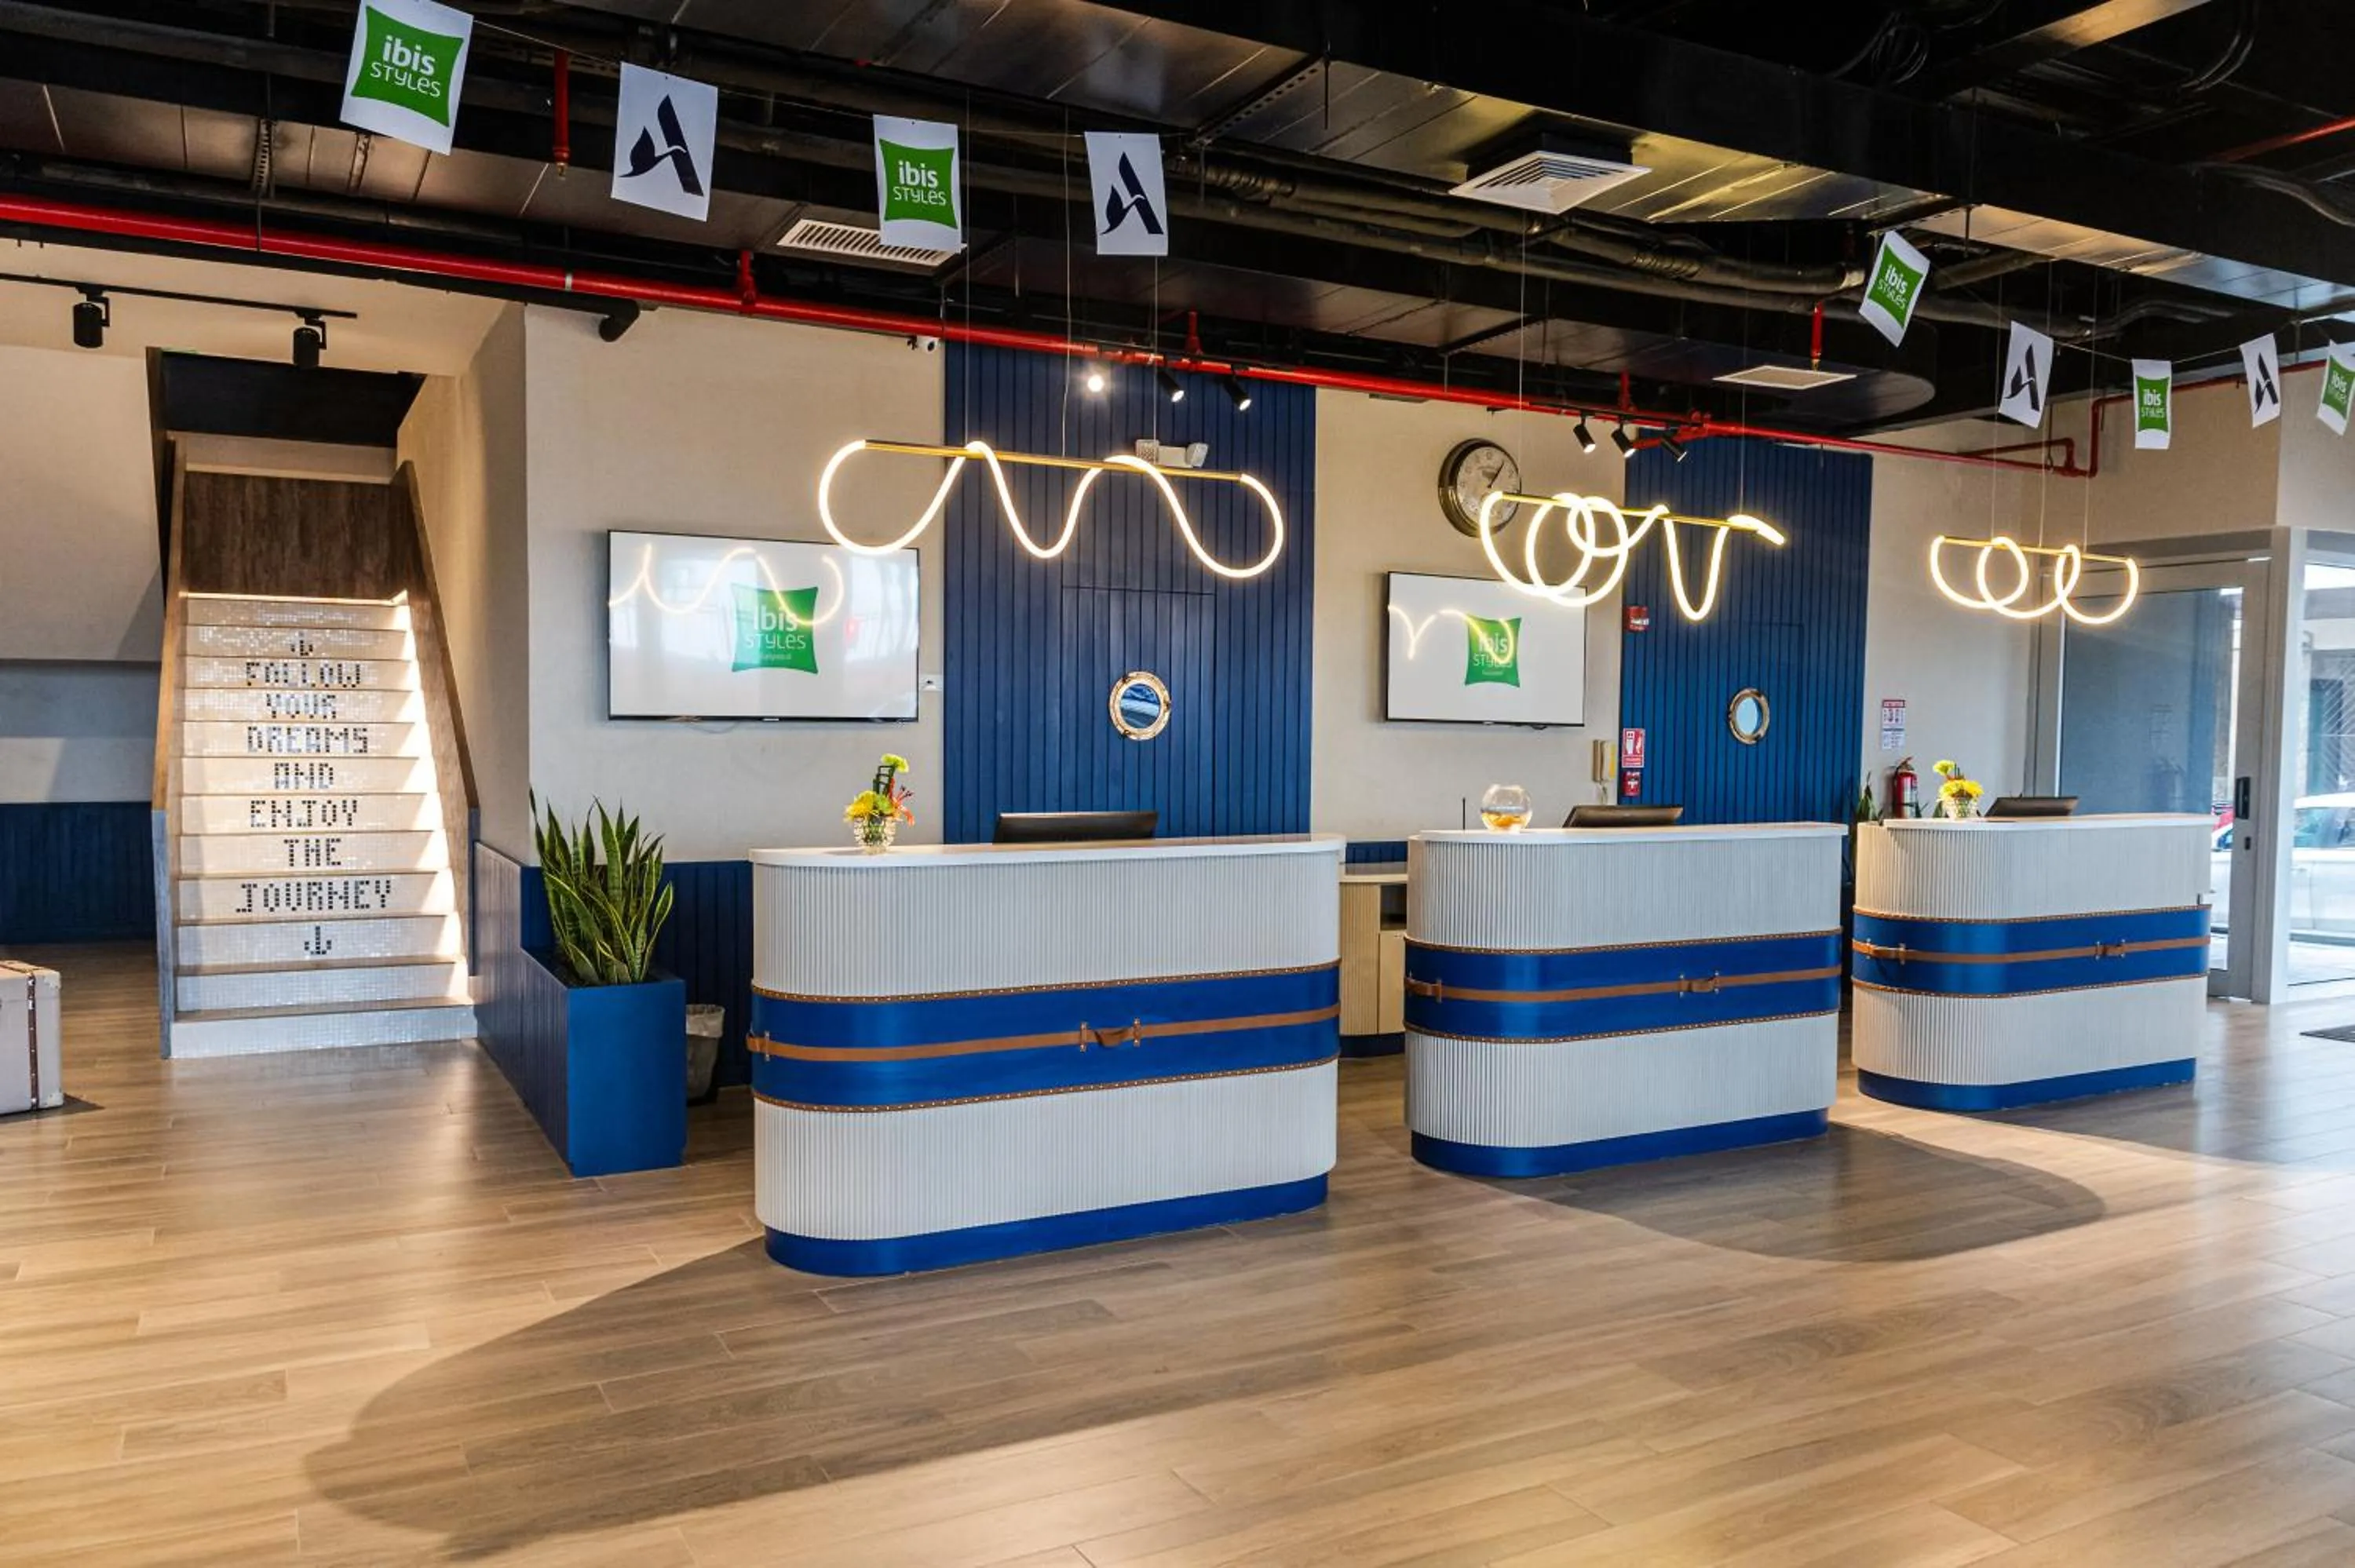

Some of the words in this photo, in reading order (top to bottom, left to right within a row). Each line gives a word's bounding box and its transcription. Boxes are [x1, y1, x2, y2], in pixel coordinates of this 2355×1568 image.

[382, 35, 436, 76] ibis
[898, 159, 939, 189] ibis
[1885, 264, 1908, 295] ibis
[2143, 388, 2162, 407] ibis
[247, 726, 368, 754] DREAMS
[274, 762, 334, 789] AND
[250, 799, 358, 828] ENJOY
[283, 837, 342, 867] THE
[236, 879, 392, 913] JOURNEY
